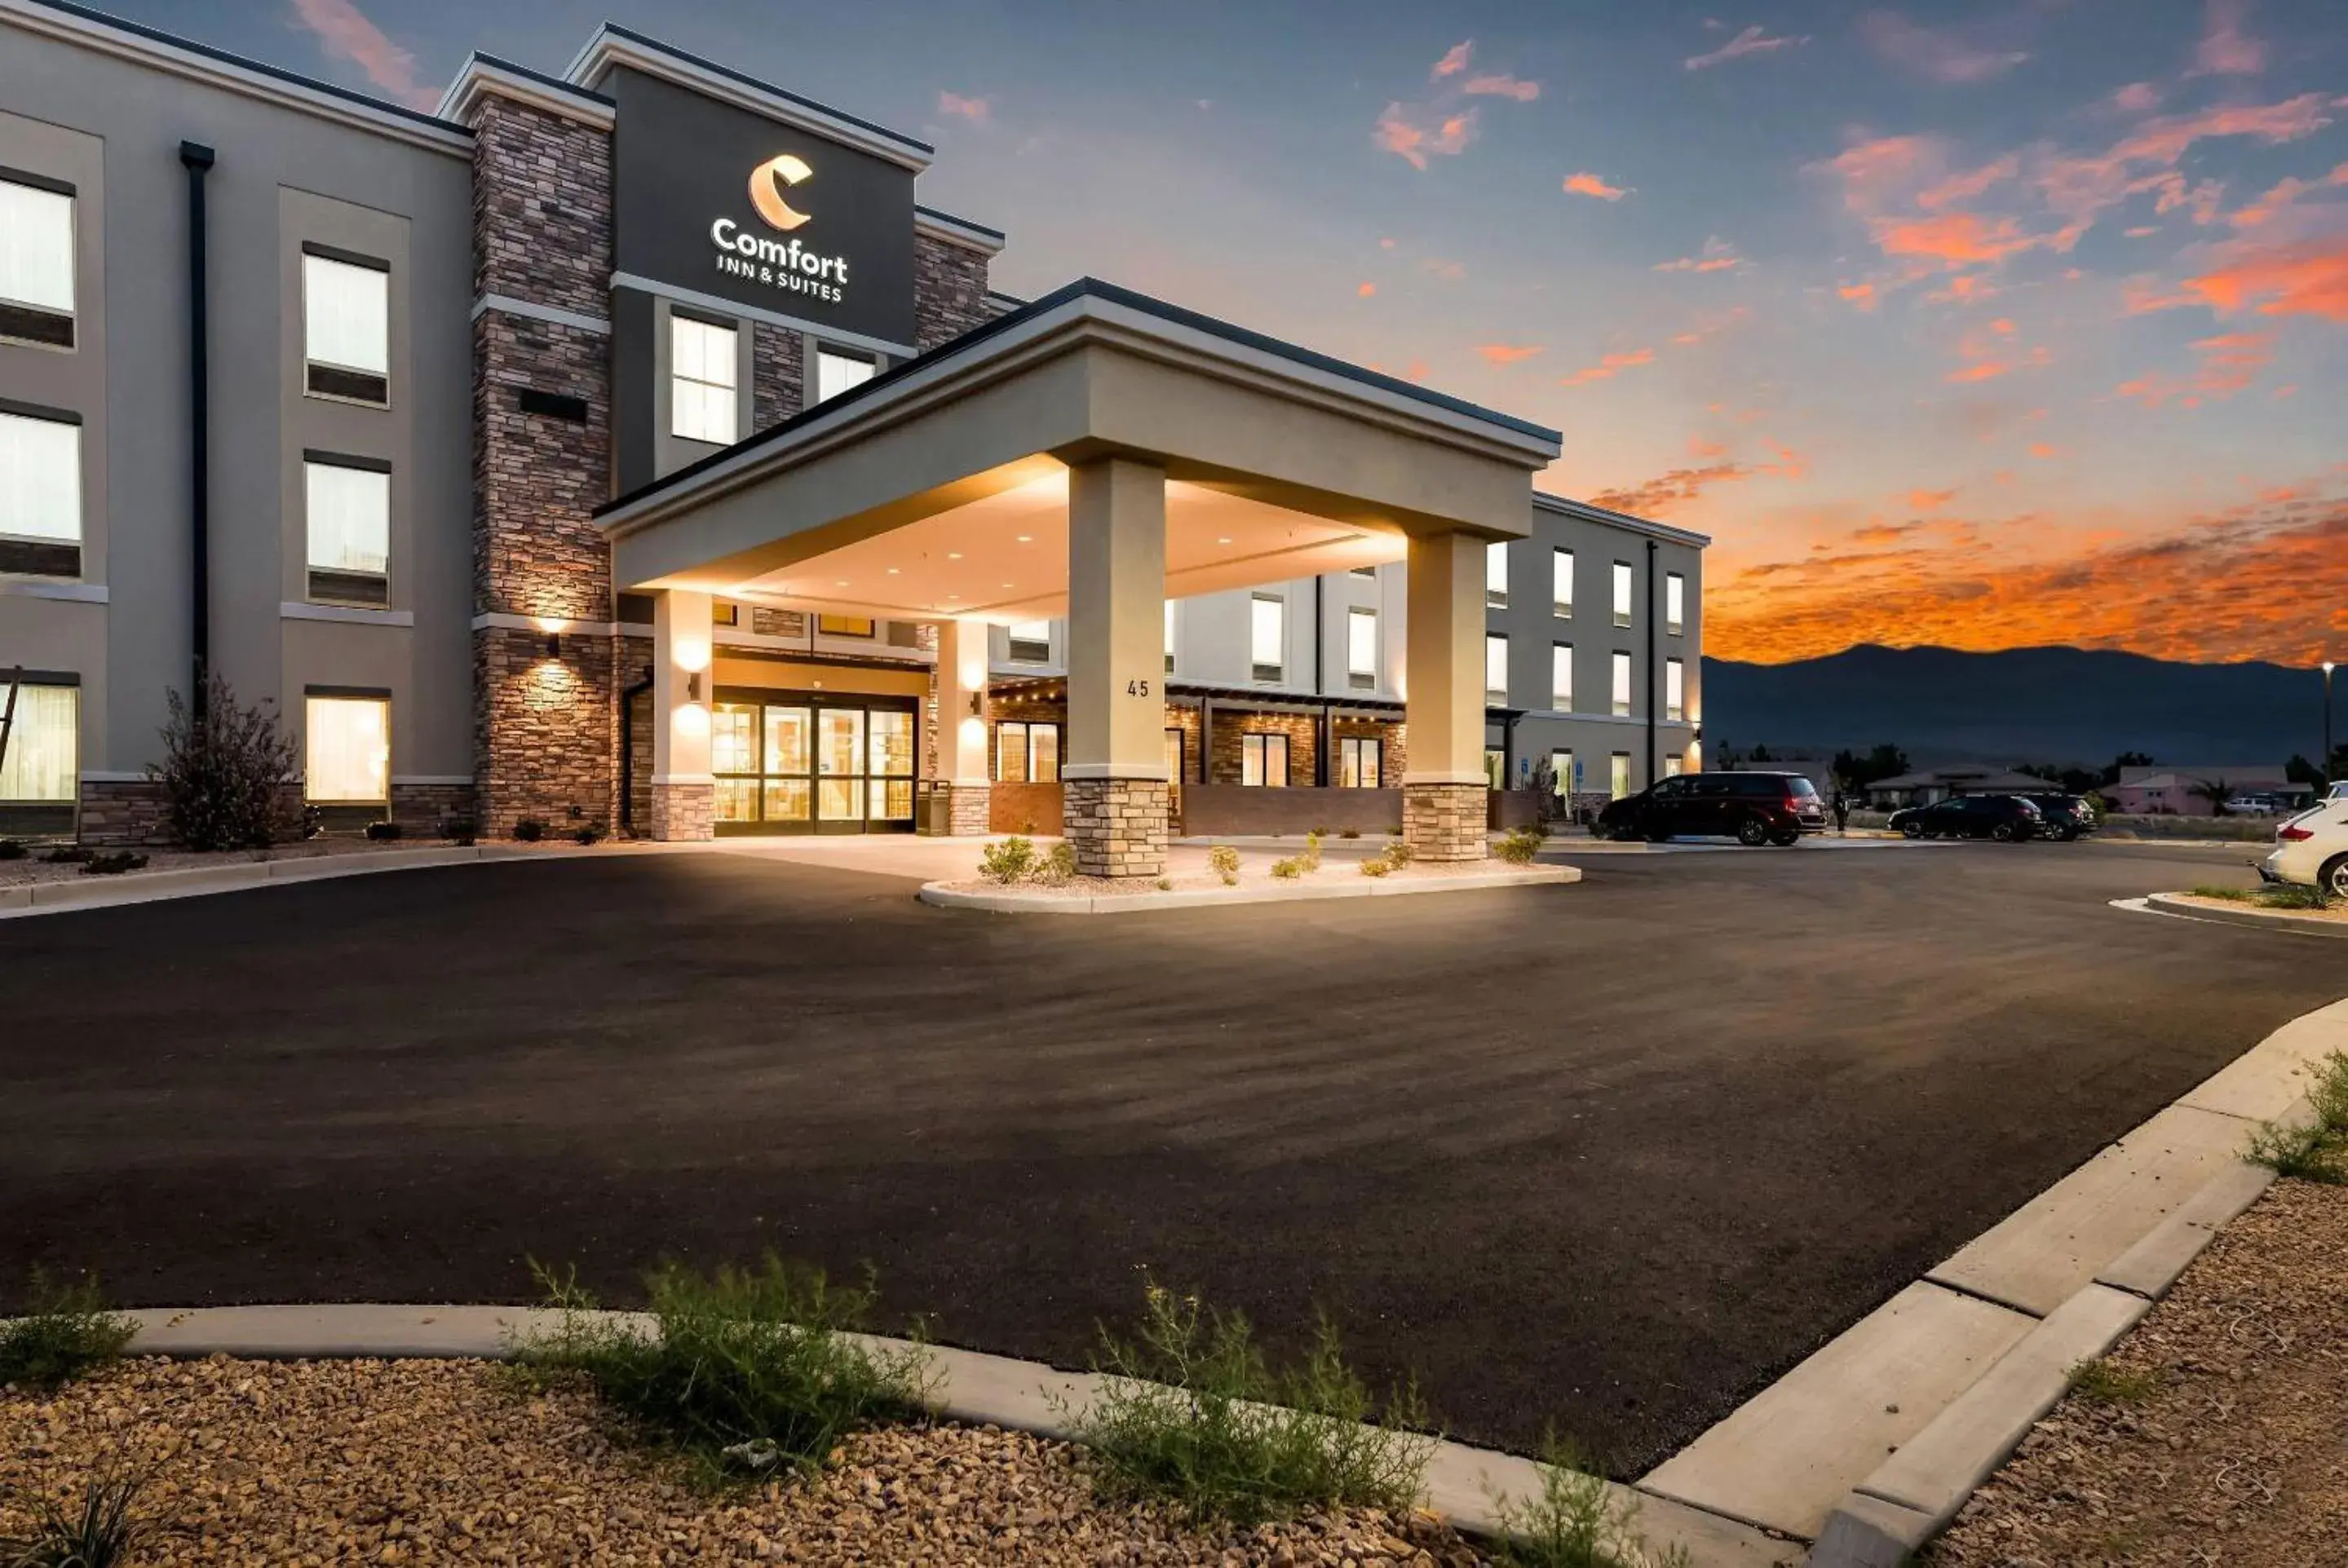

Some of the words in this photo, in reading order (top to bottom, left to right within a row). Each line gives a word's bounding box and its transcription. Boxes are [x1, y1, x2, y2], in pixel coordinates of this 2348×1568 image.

[711, 218, 848, 285] Comfort
[716, 254, 755, 279] INN
[760, 267, 772, 283] &
[778, 272, 842, 303] SUITES
[1128, 680, 1148, 697] 45
